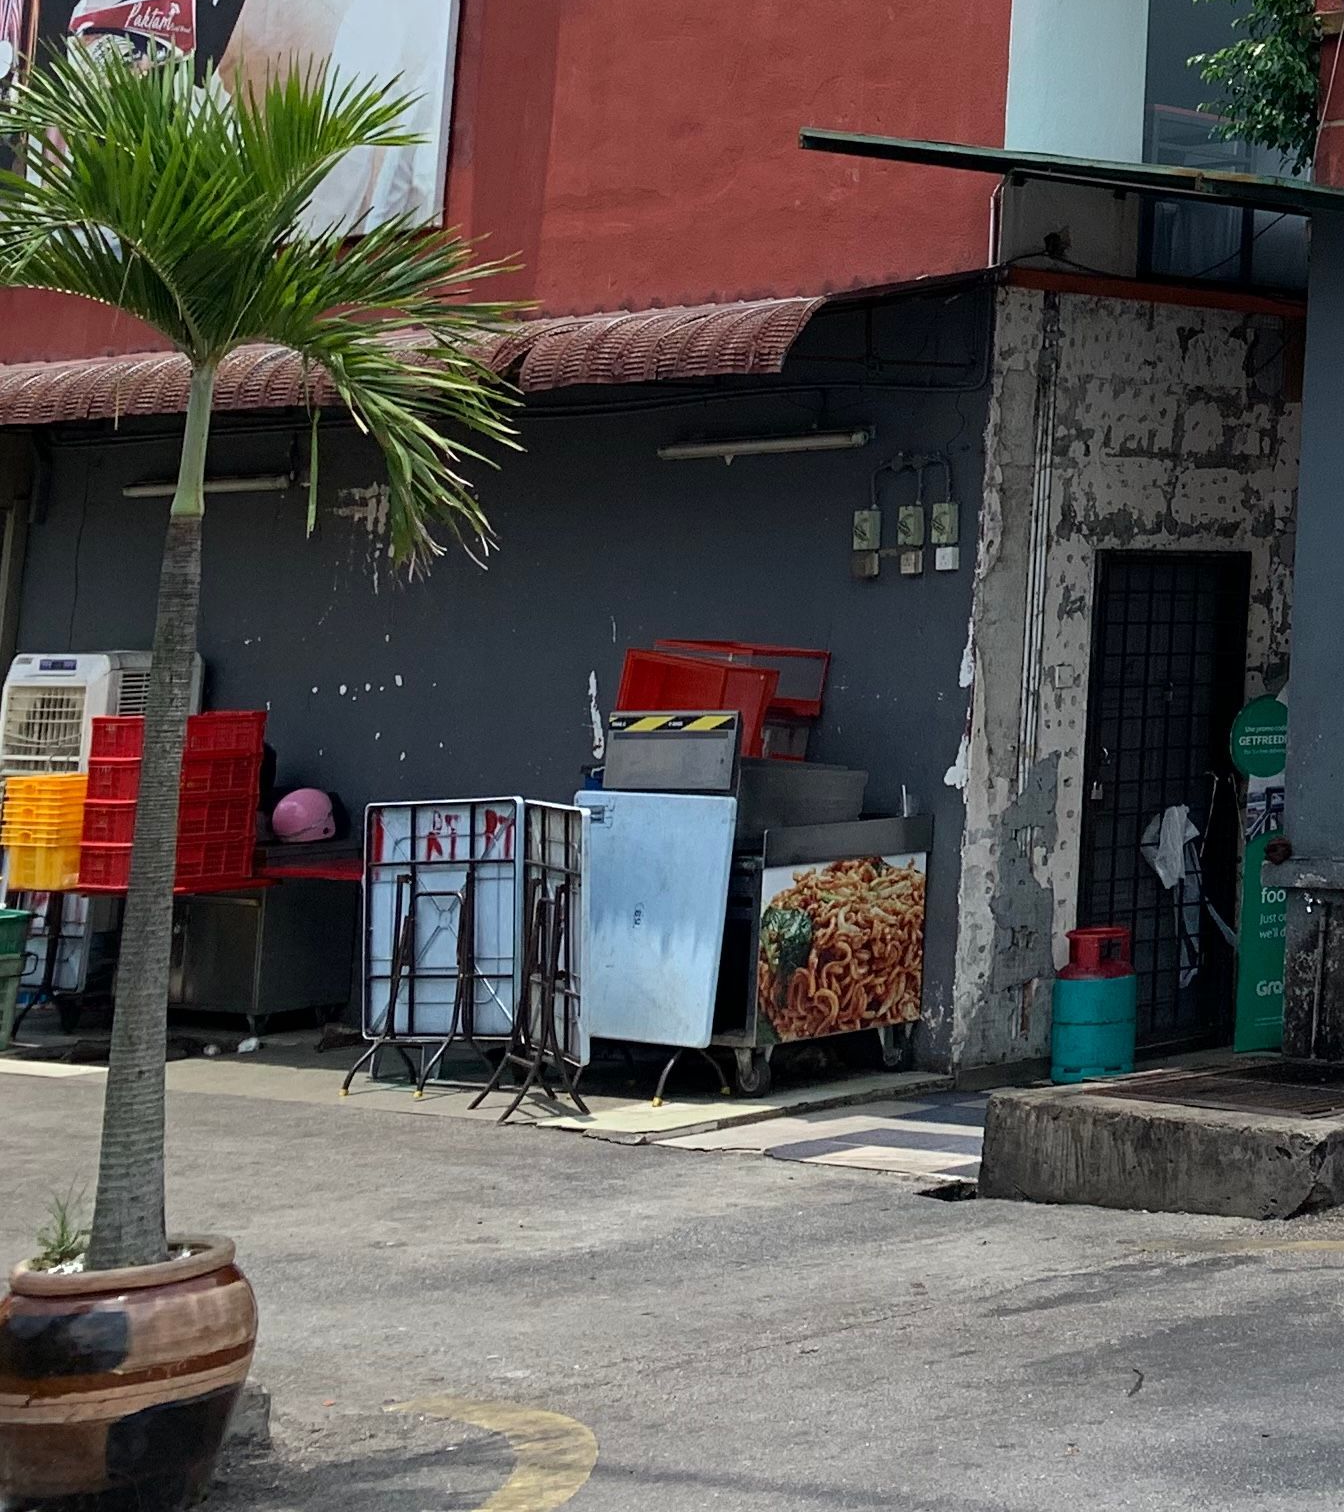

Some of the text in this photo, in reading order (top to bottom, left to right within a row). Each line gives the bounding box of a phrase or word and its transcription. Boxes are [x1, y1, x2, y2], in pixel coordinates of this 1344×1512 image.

[1261, 887, 1287, 904] foo
[1259, 913, 1277, 925] Just
[1256, 980, 1284, 996] Gra
